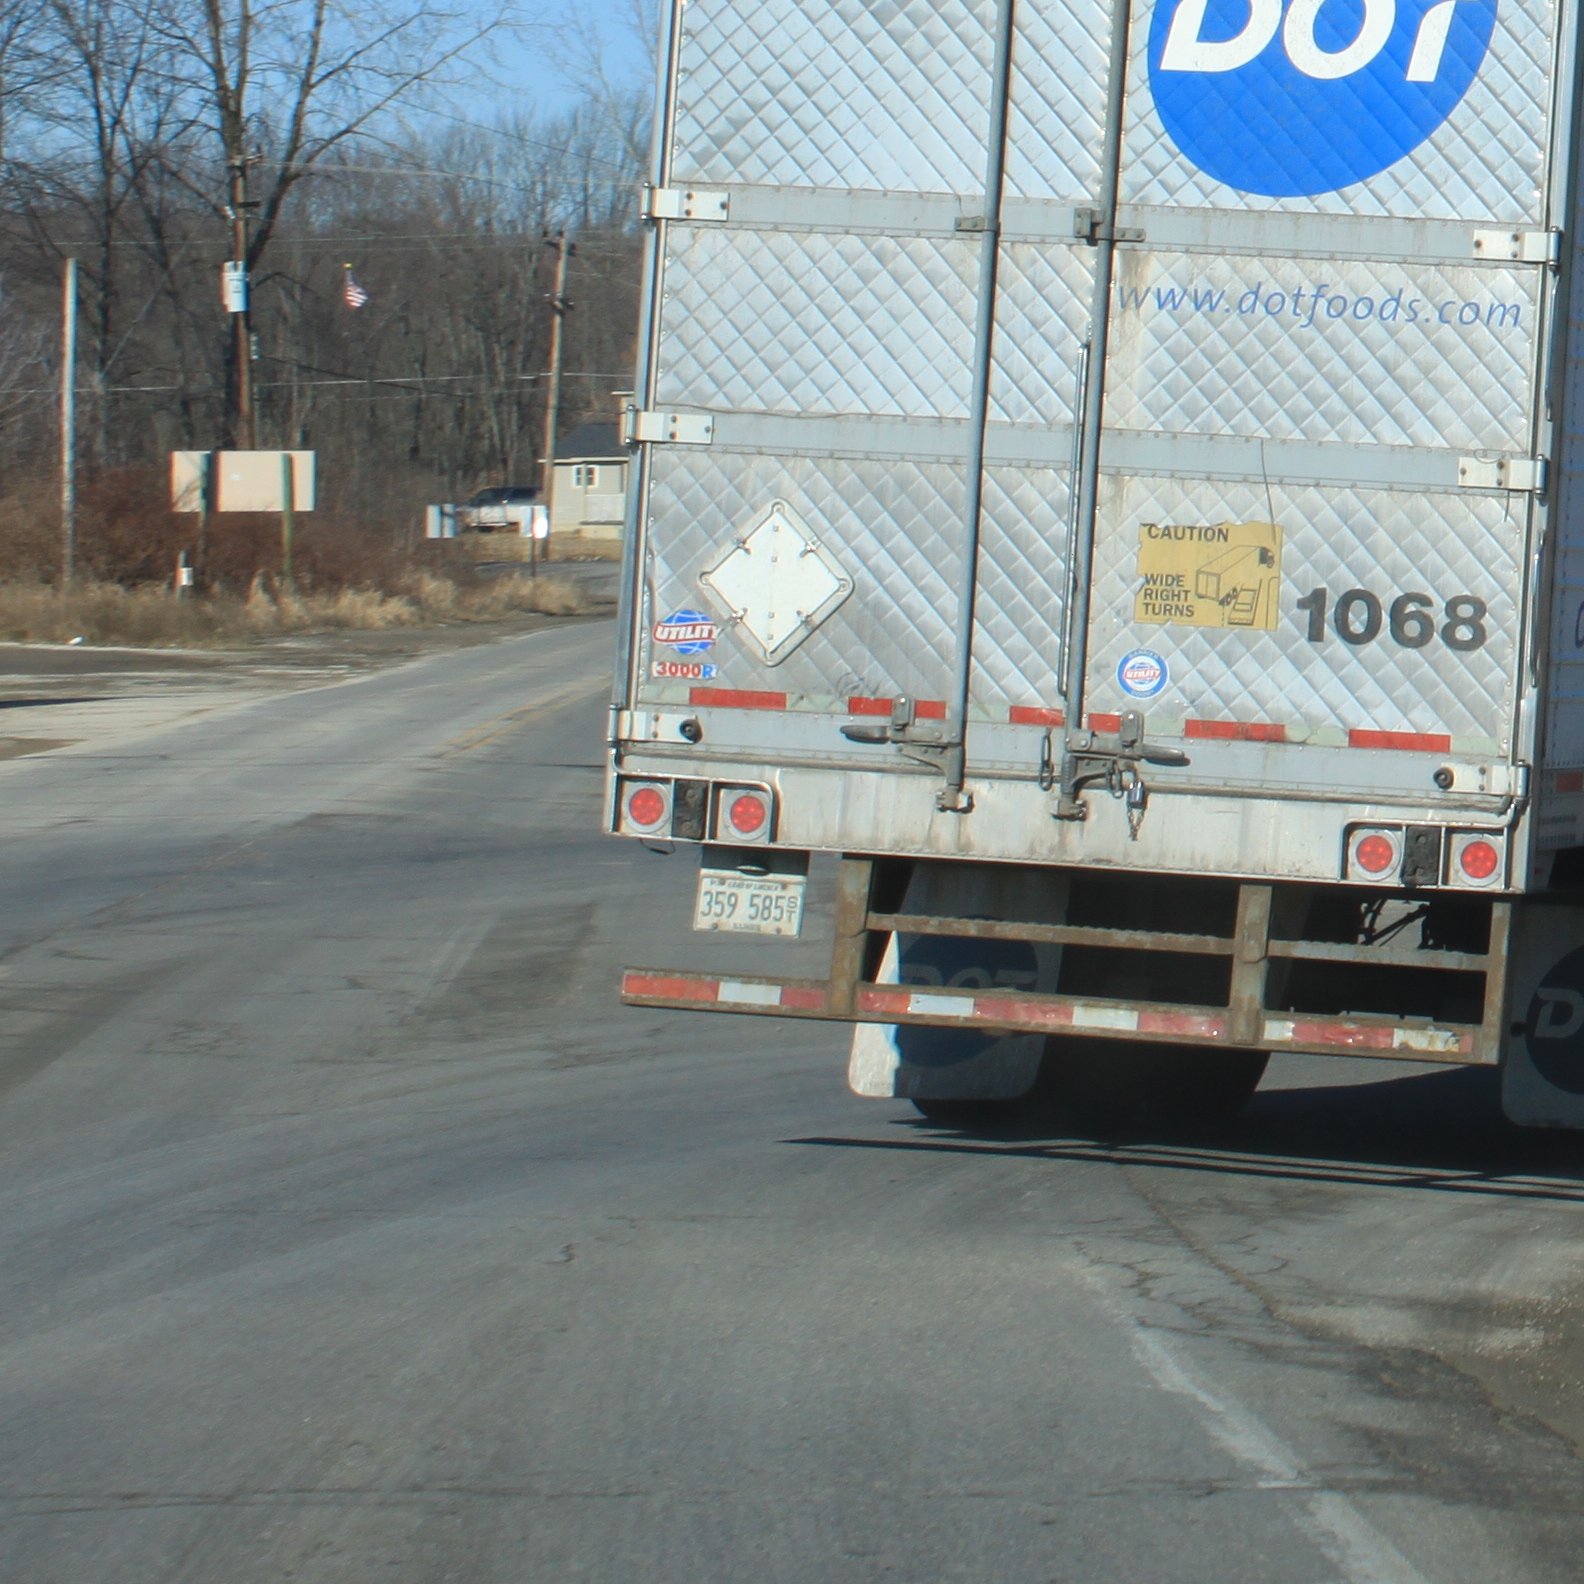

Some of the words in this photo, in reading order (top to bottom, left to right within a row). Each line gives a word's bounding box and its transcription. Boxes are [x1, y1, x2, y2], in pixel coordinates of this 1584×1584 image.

[1119, 280, 1522, 328] www.dotfoods.com
[1147, 525, 1229, 543] CAUTION
[1144, 573, 1185, 588] WIDE
[1143, 588, 1191, 603] RIGHT
[1142, 602, 1195, 618] TURNS
[1296, 587, 1488, 652] 1068
[656, 661, 714, 679] 3000R
[701, 891, 738, 919] 359
[748, 894, 784, 922] 585
